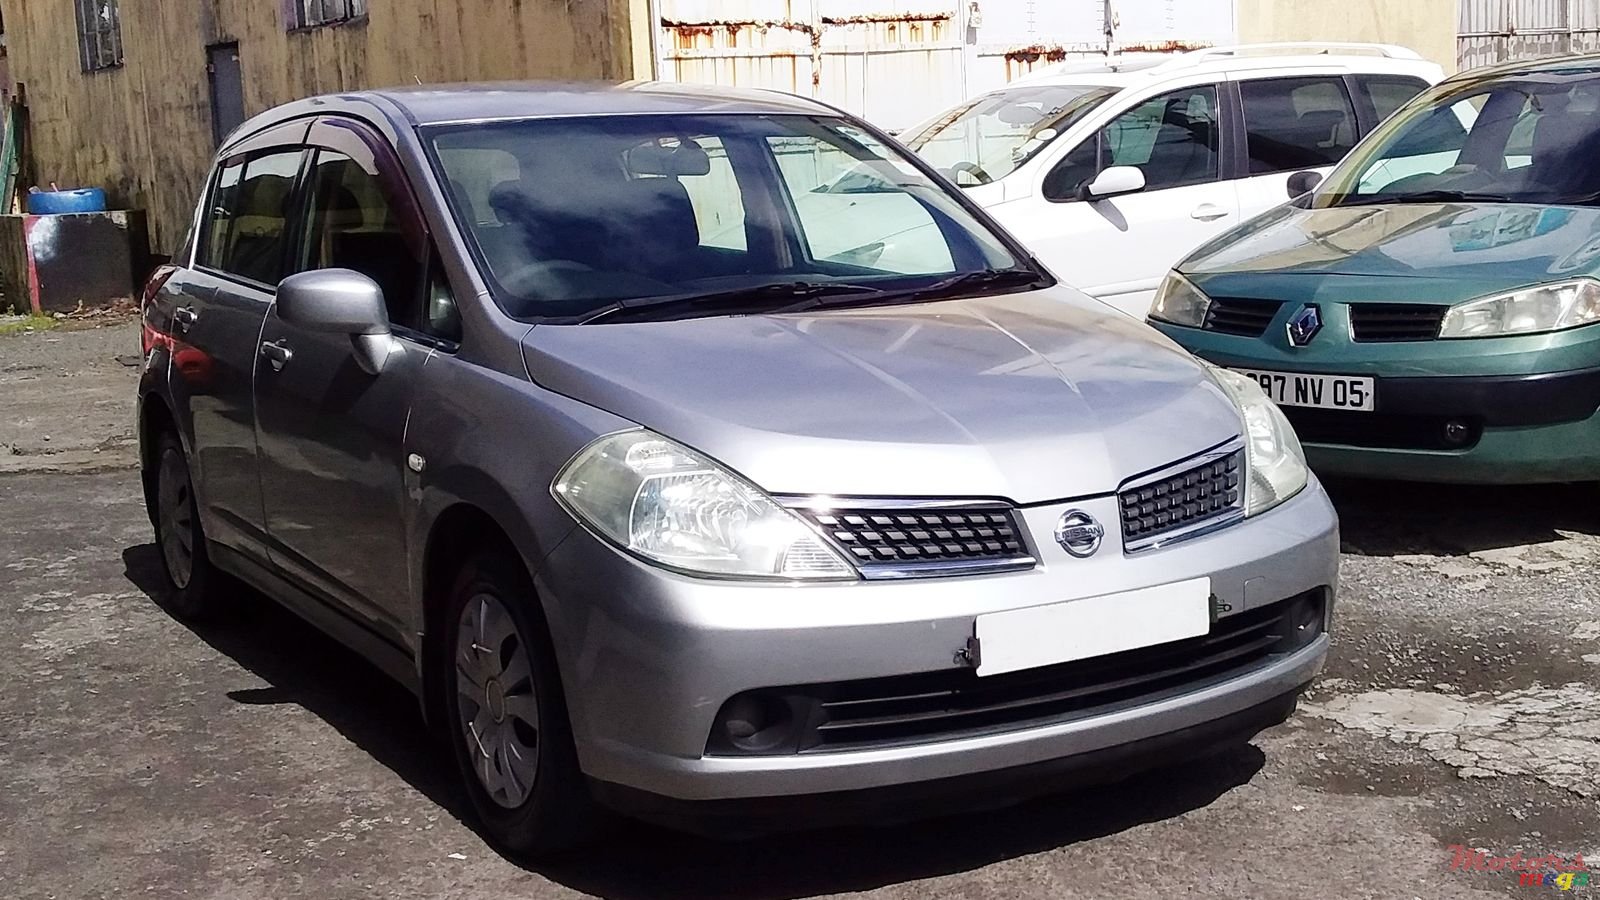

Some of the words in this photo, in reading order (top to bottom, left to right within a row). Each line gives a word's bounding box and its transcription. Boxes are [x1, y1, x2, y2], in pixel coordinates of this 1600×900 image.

[1246, 372, 1287, 402] 97
[1295, 377, 1324, 405] NV
[1333, 379, 1364, 407] 05
[1062, 527, 1101, 539] NISSAN
